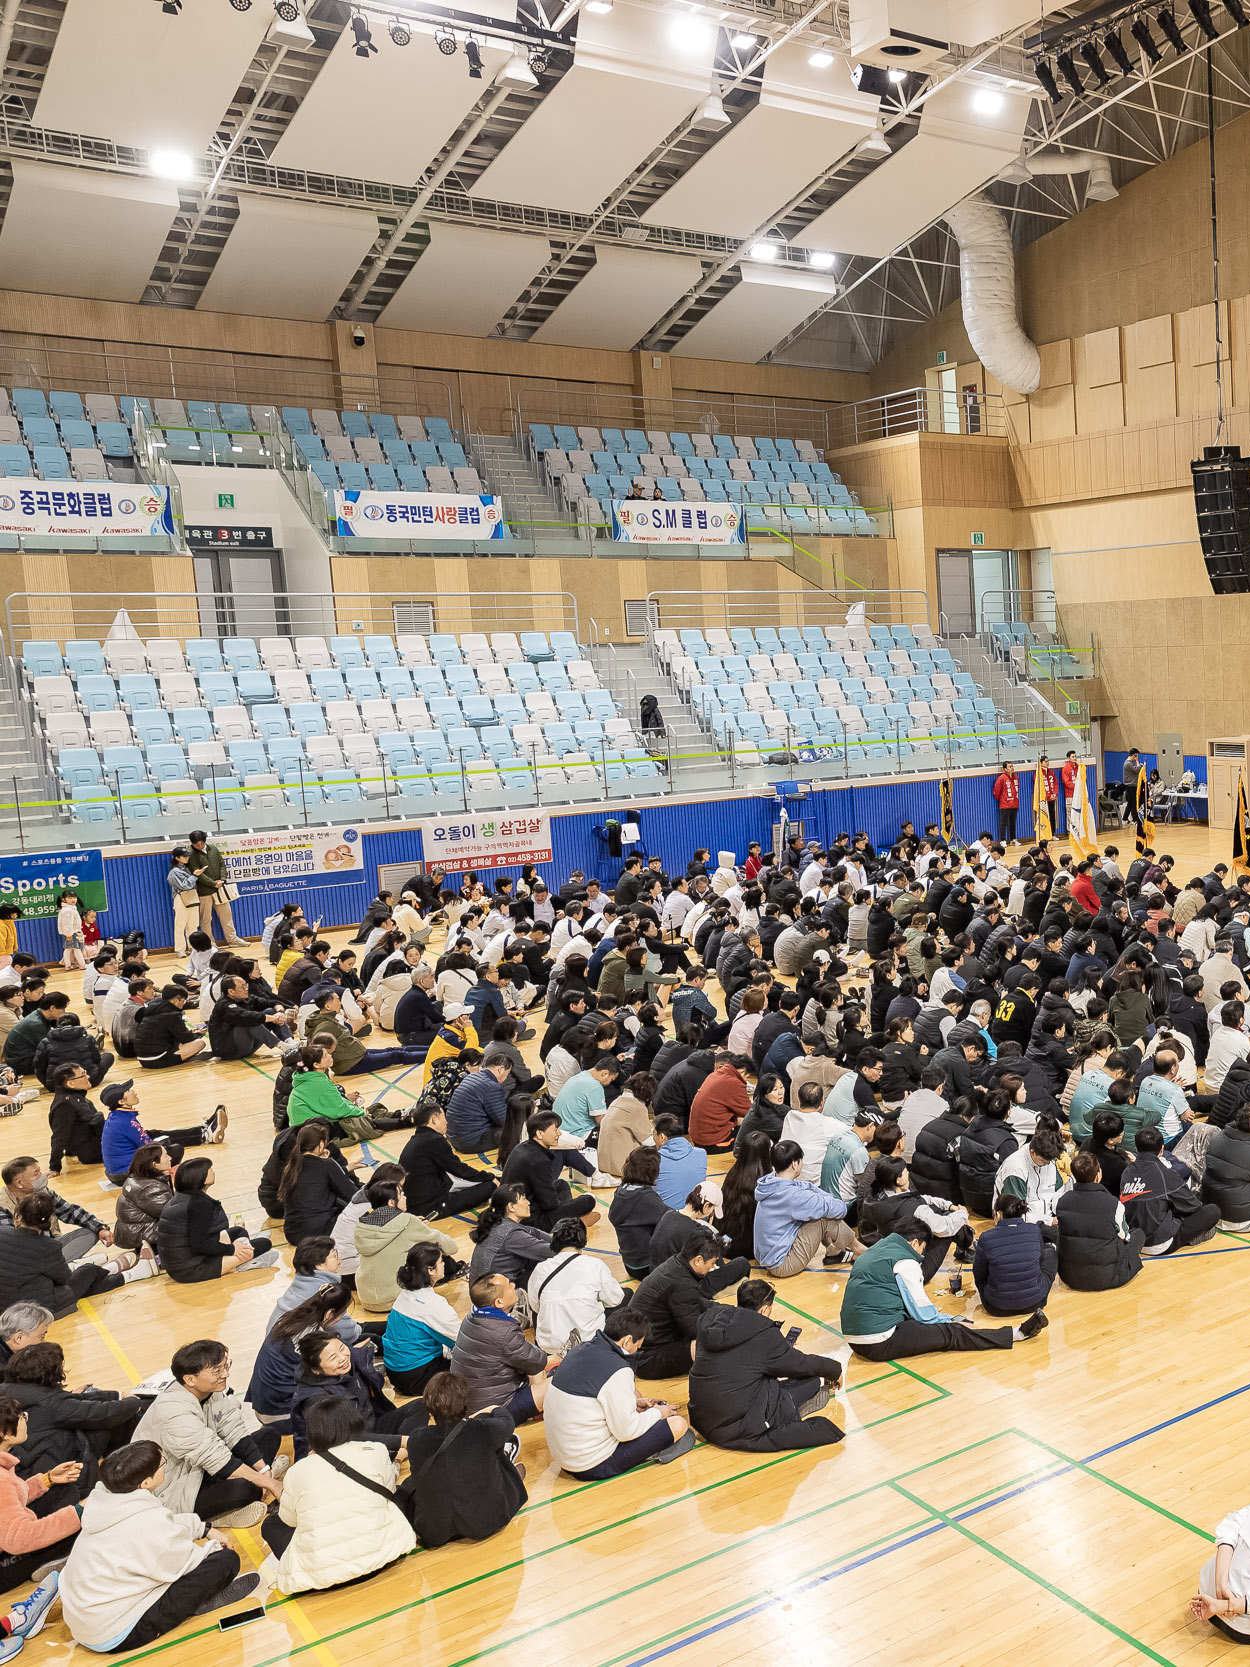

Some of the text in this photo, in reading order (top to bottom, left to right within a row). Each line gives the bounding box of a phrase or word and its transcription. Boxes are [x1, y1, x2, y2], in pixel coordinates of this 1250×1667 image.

[19, 490, 161, 518] 중곡문화클럽 승
[343, 504, 496, 525] 필 동국민턴사랑클럽 승
[620, 510, 631, 525] 필
[652, 508, 677, 529] S.M
[726, 514, 738, 527] 승
[0, 525, 36, 533] awasaki
[232, 530, 242, 540] 번
[246, 530, 267, 540] 출구
[433, 818, 541, 841] 오돌이 생 삼겹살
[254, 854, 283, 866] 응원의
[285, 849, 313, 862] 마음을
[462, 860, 468, 868] &
[233, 862, 315, 879] 단팥빵에 담았습니다
[0, 873, 80, 896] Sports
[269, 879, 308, 889] BAGUETTE
[995, 999, 1016, 1022] 33
